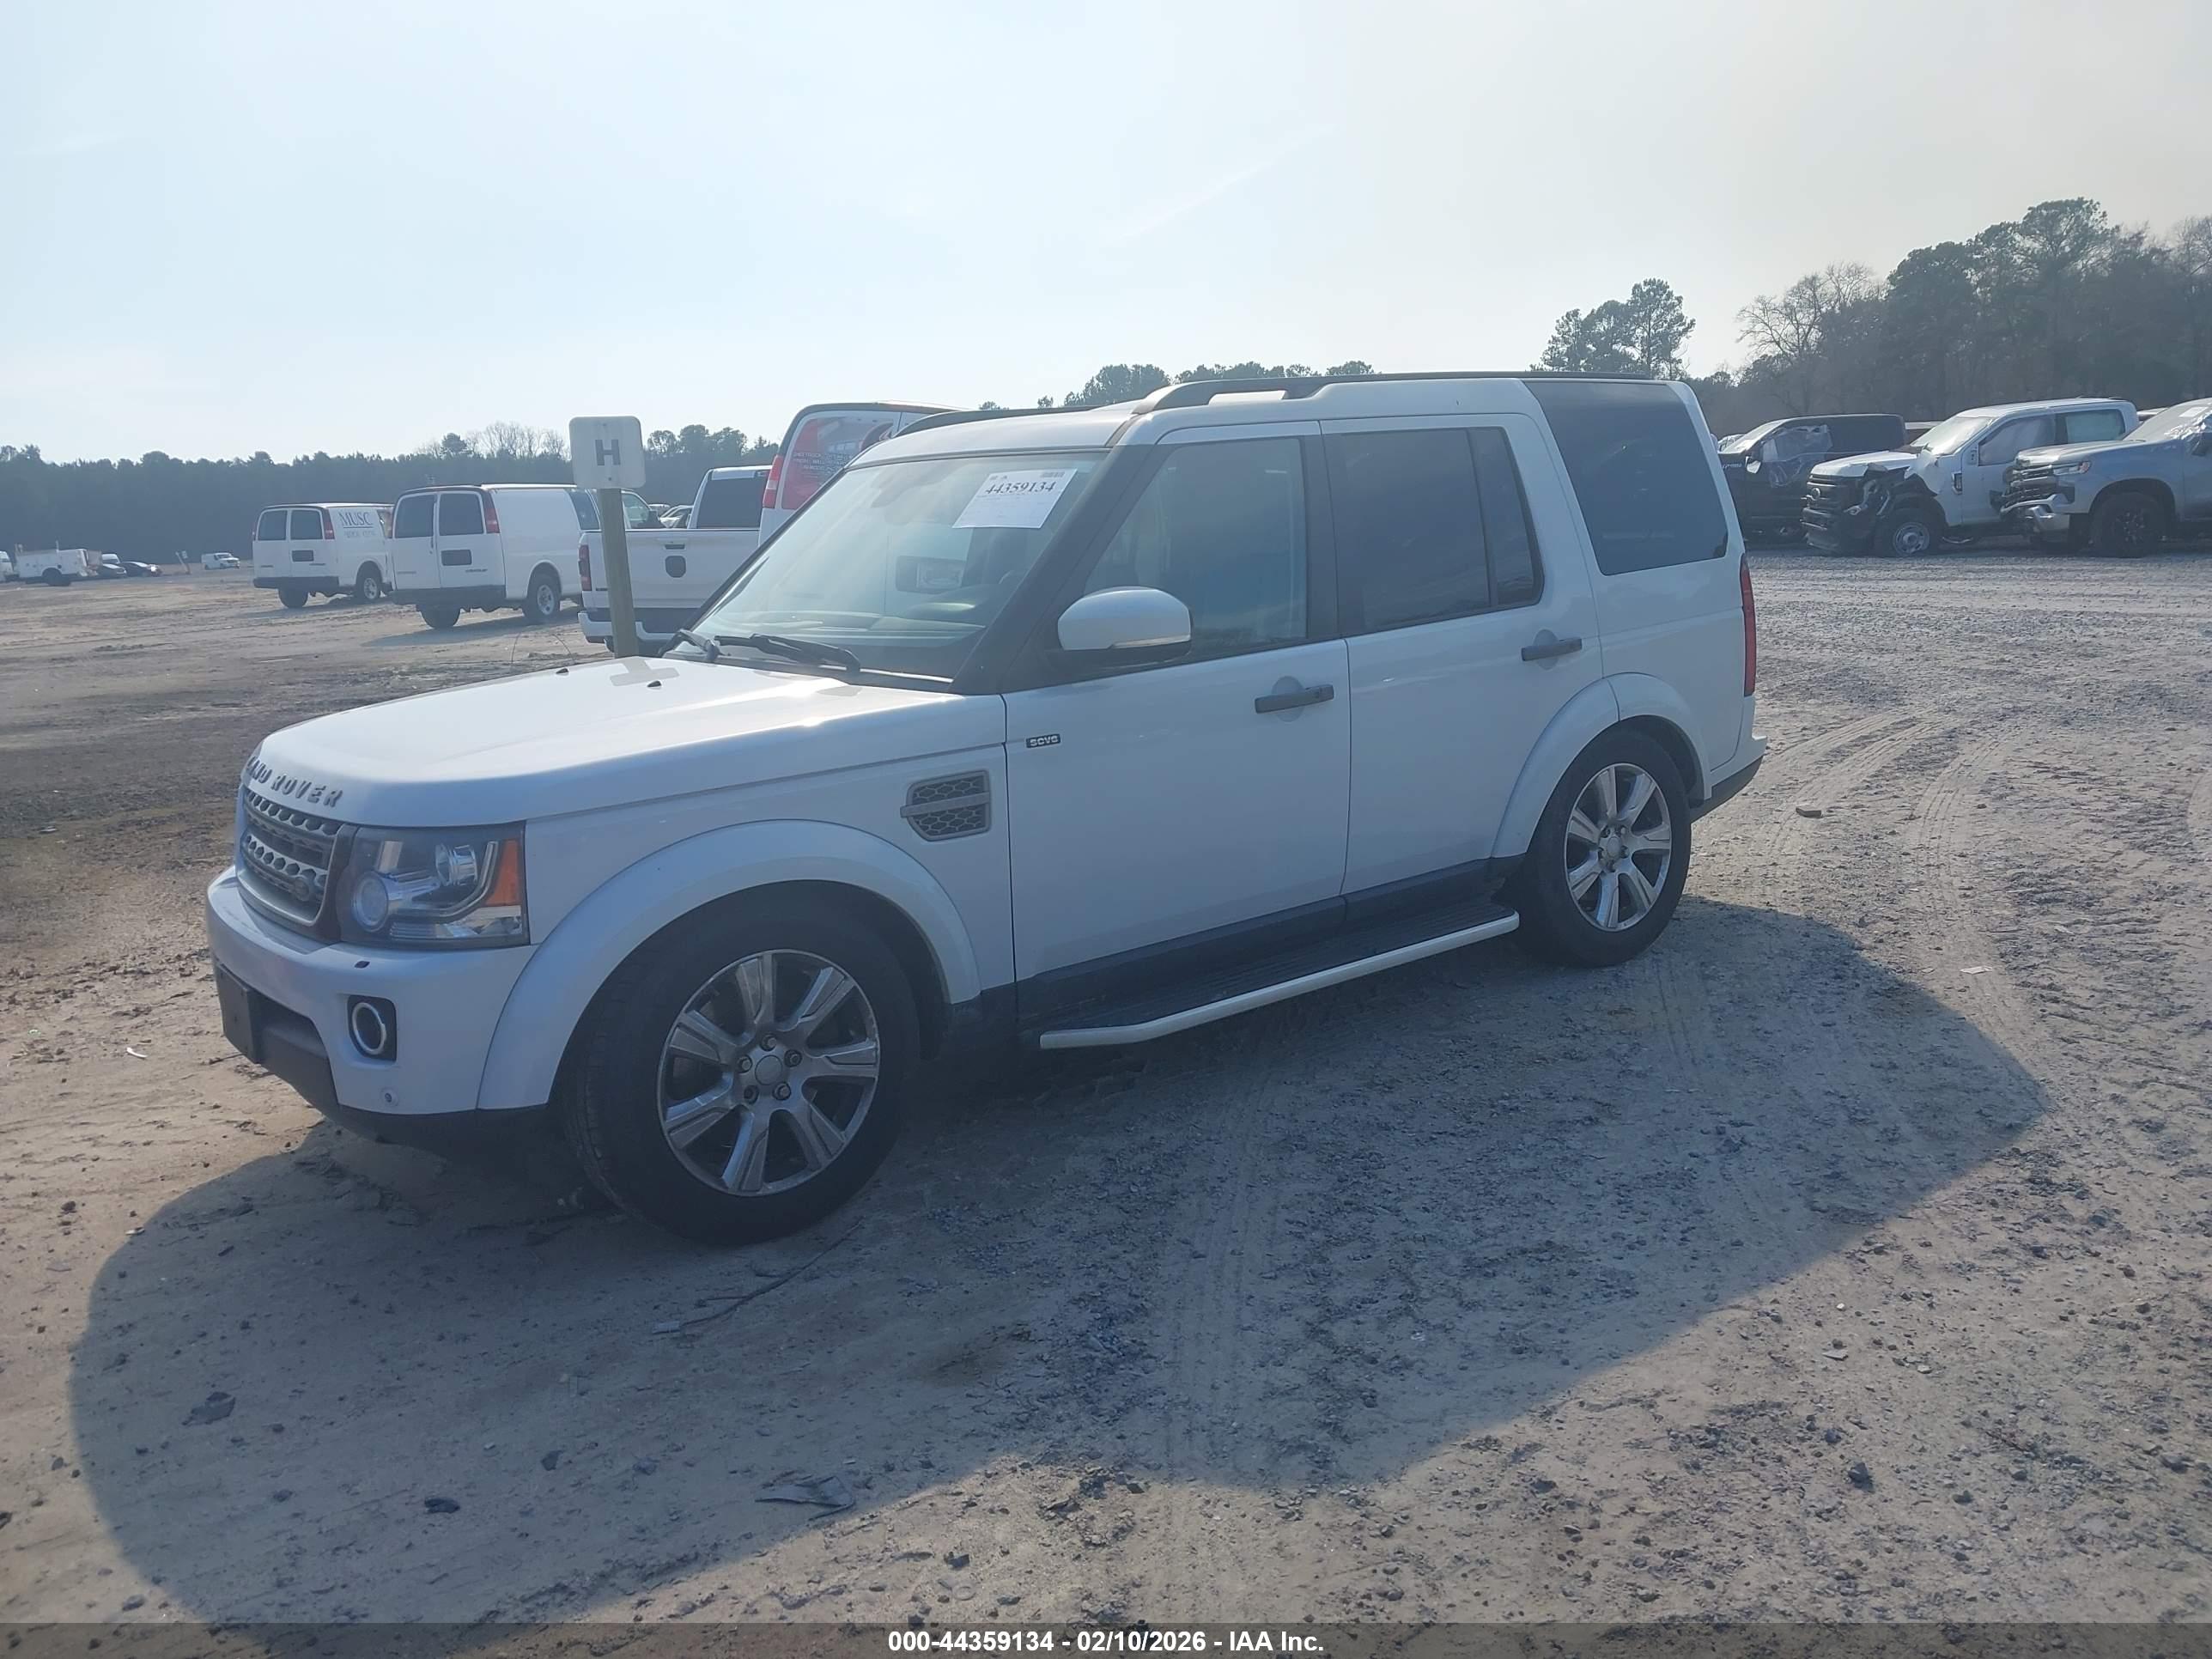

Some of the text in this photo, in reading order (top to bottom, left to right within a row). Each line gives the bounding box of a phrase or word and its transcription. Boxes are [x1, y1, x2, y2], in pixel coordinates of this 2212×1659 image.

[595, 439, 621, 466] H
[985, 481, 1057, 495] 44359134
[338, 512, 374, 526] MUSC
[270, 775, 343, 807] ROVER
